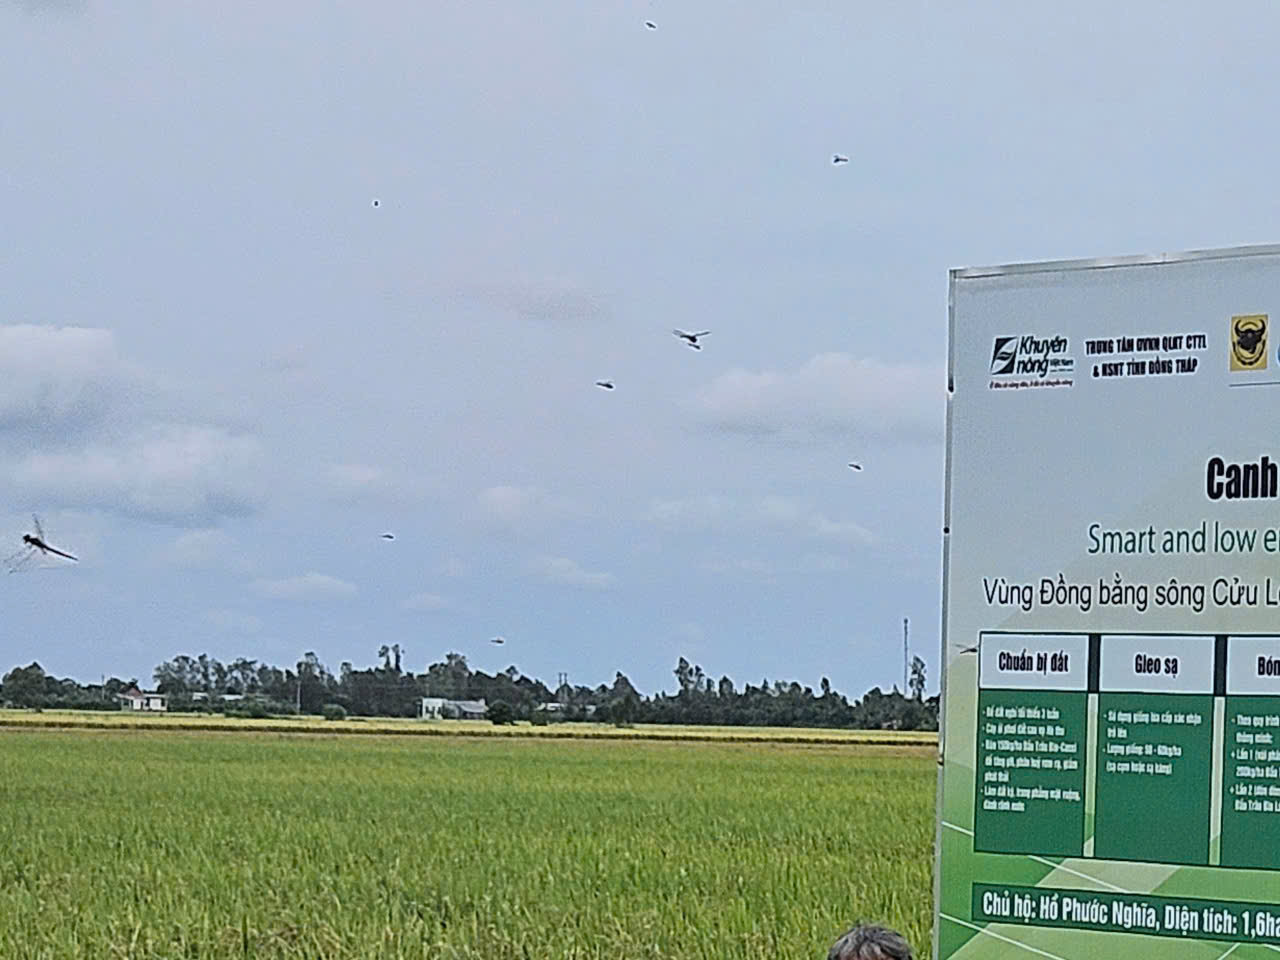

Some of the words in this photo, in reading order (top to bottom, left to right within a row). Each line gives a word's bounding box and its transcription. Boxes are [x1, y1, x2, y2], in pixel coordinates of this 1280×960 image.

[1086, 338, 1113, 355] TRUNG
[1017, 356, 1049, 377] nông
[1175, 357, 1198, 373] THÁP
[1206, 456, 1278, 500] Canh
[1088, 523, 1156, 554] Smart
[1162, 521, 1206, 554] and
[1213, 521, 1257, 553] low
[983, 578, 1033, 611] Vùng
[1039, 572, 1092, 612] Đồng
[1099, 571, 1148, 612] bằng
[1154, 579, 1205, 612] sông
[1212, 577, 1258, 606] Cửu
[1135, 654, 1161, 674] Gieo
[1164, 658, 1178, 678] sạ
[1258, 655, 1280, 677] Bón
[983, 890, 1010, 917] Chủ
[1014, 899, 1037, 923] hộ:
[1040, 892, 1058, 920] Hồ
[1062, 897, 1108, 925] Phước
[1112, 901, 1161, 931] Nghĩa,
[1164, 905, 1199, 935] Diện
[1203, 907, 1238, 935] tích:
